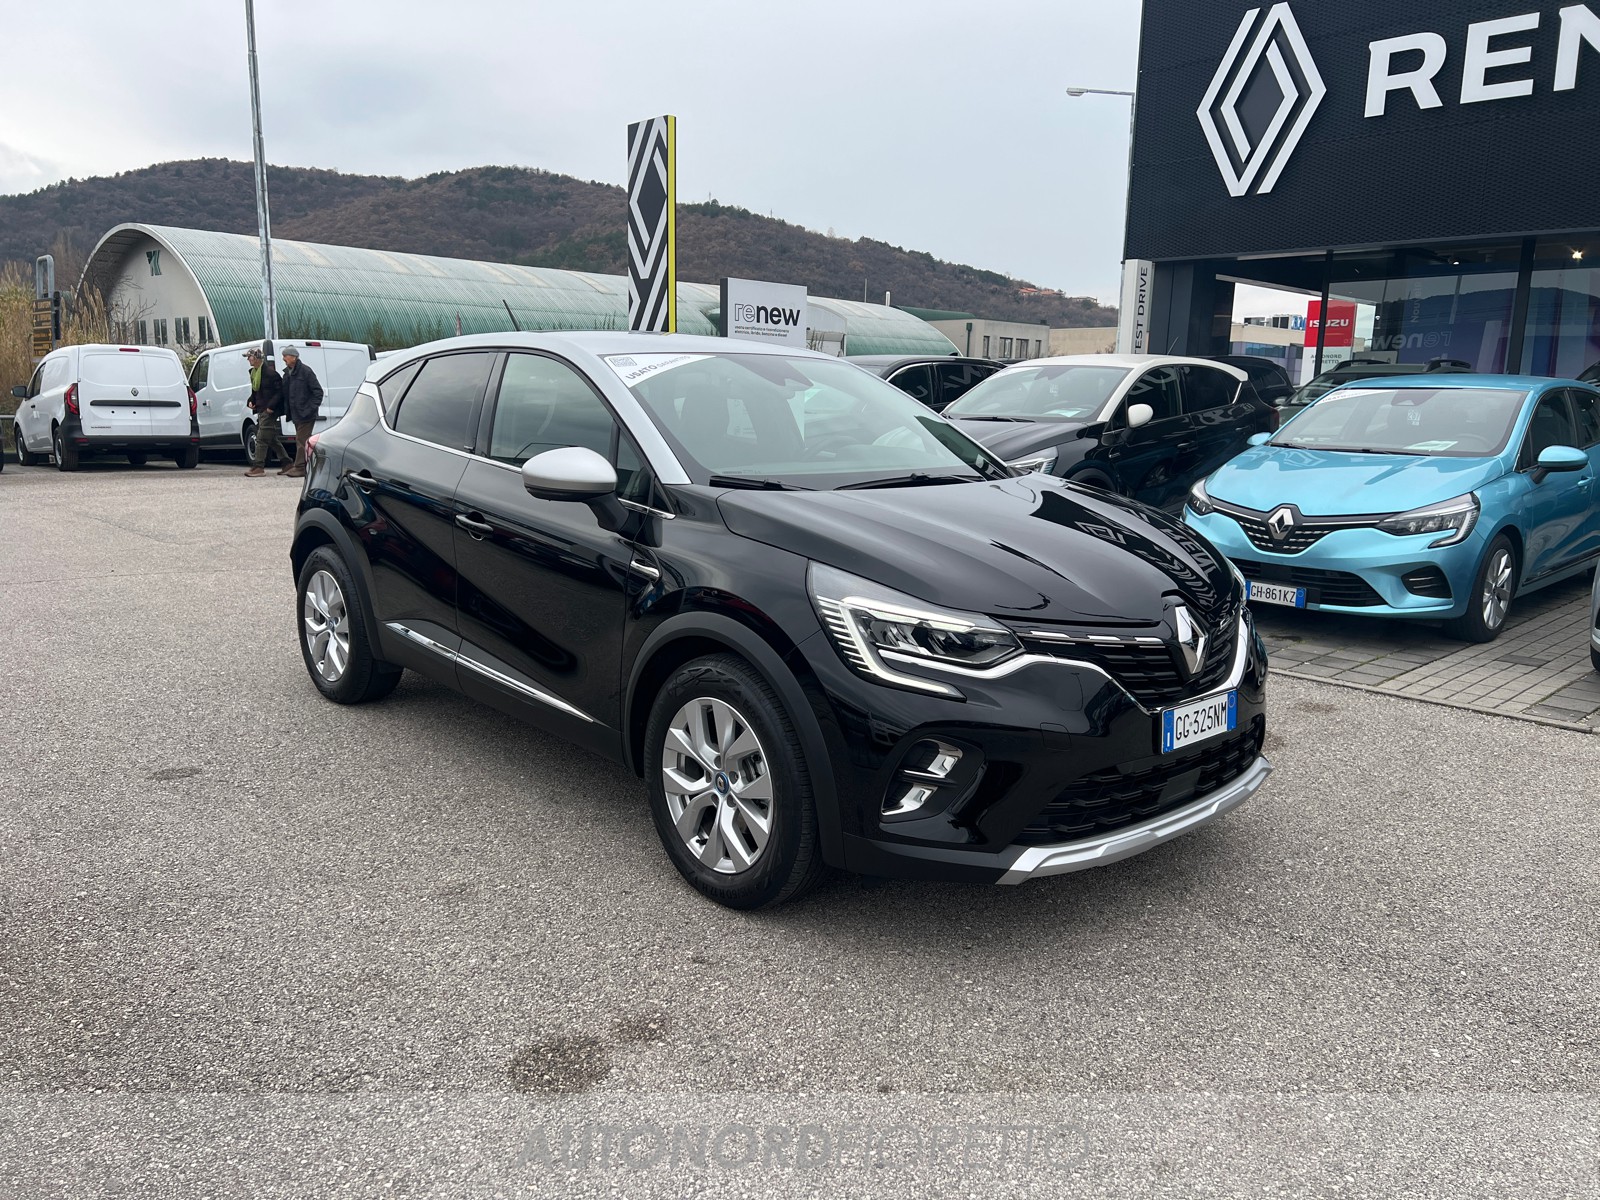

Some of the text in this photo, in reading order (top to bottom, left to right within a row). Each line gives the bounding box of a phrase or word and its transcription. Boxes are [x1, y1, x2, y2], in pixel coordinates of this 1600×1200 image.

[1138, 267, 1148, 316] DRIVE
[734, 303, 801, 326] renew
[625, 364, 658, 380] USATO
